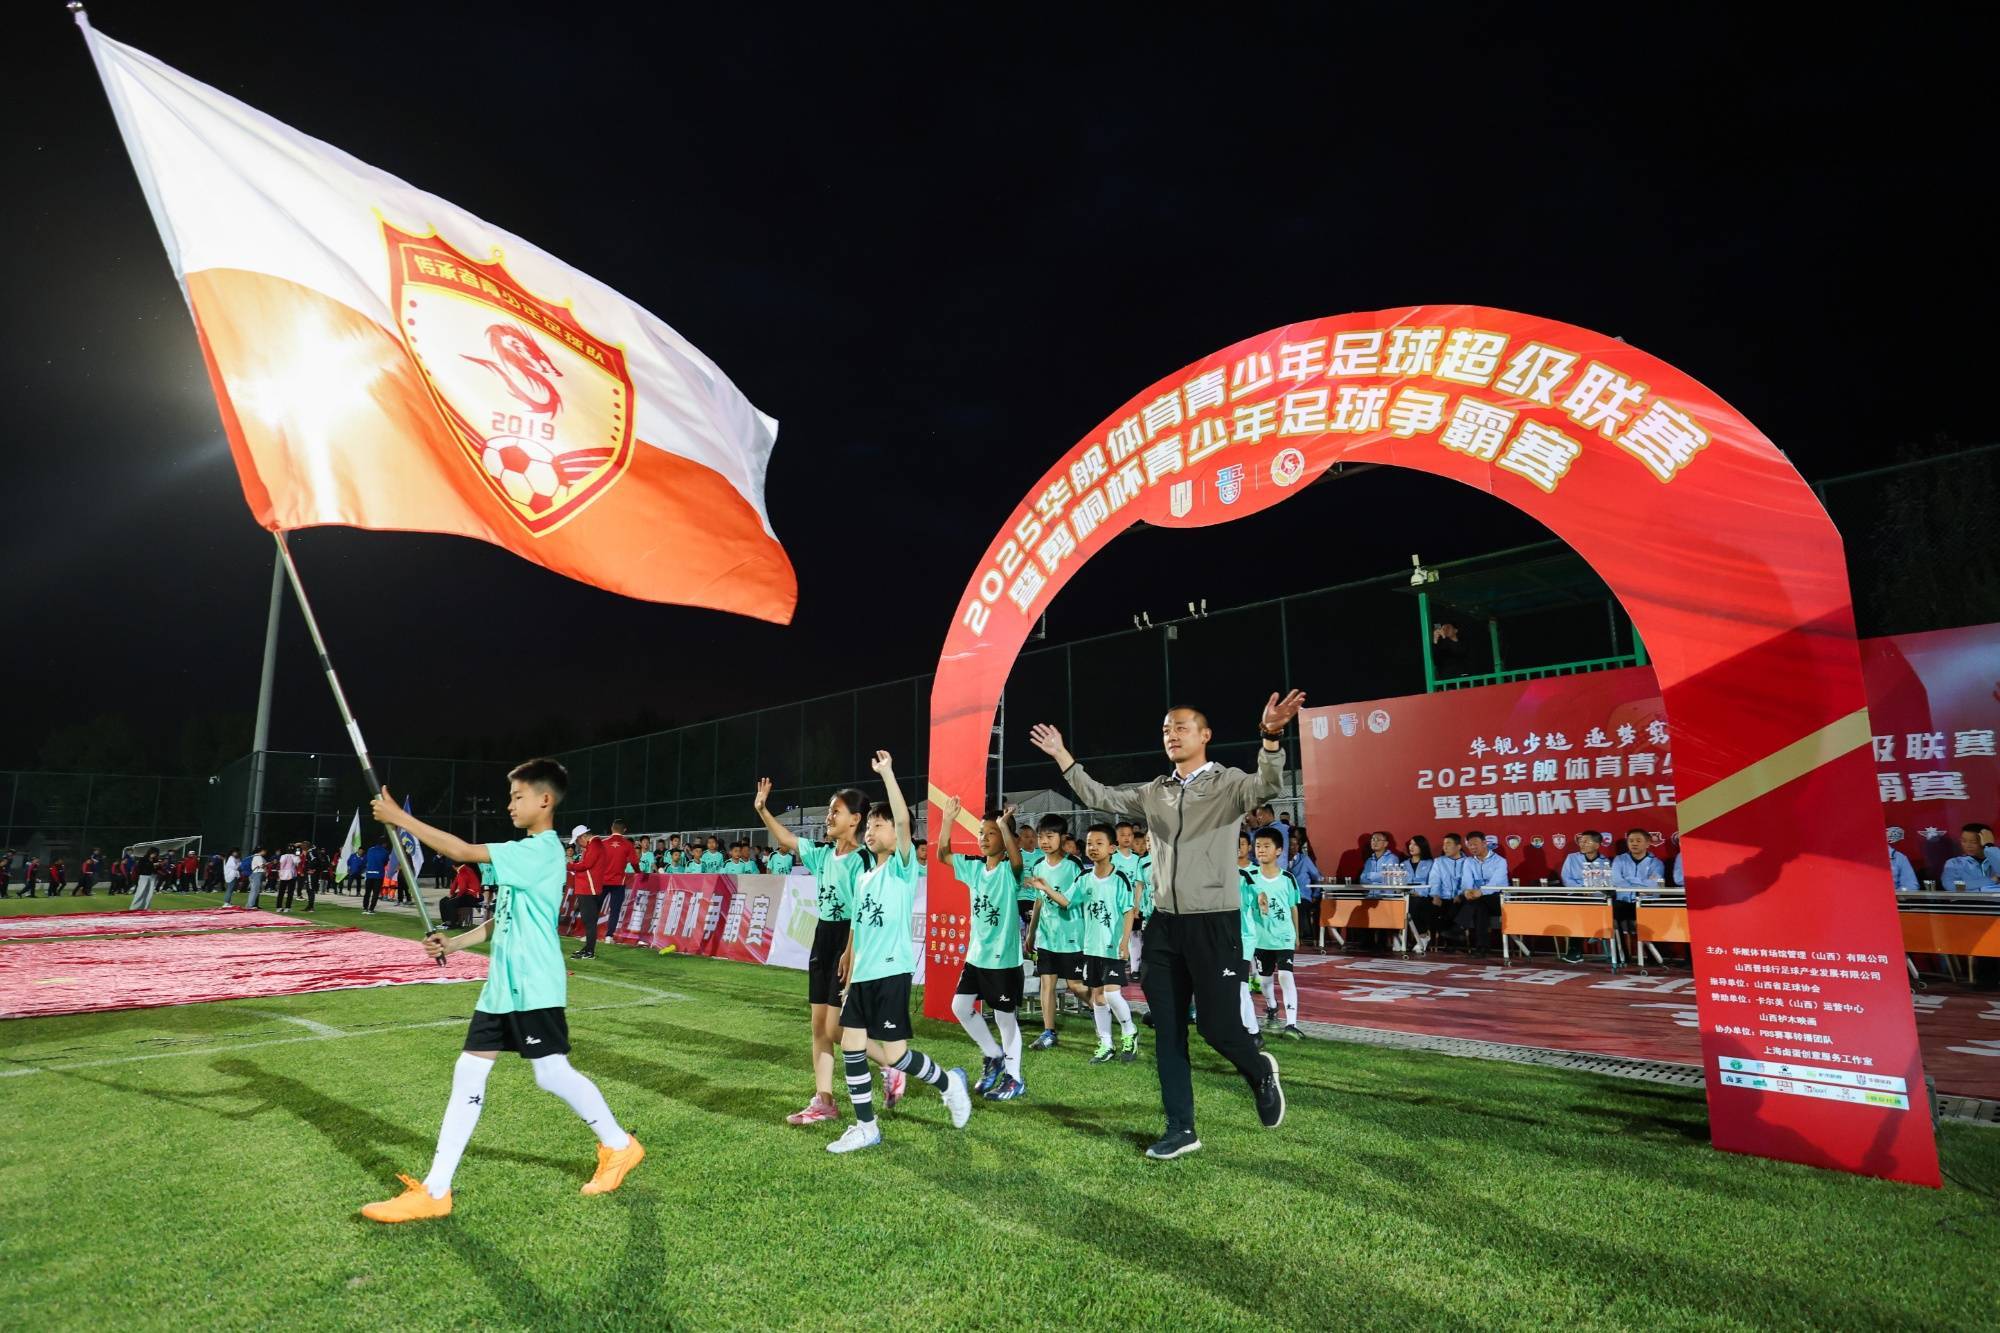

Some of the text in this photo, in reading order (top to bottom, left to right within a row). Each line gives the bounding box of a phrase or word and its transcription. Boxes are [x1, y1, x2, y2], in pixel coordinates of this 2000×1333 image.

[492, 411, 555, 440] 2019
[963, 326, 1711, 637] 2025华舰体育青少年足球超级联赛
[1007, 385, 1582, 614] 暨剪桐杯青少年足球争霸赛
